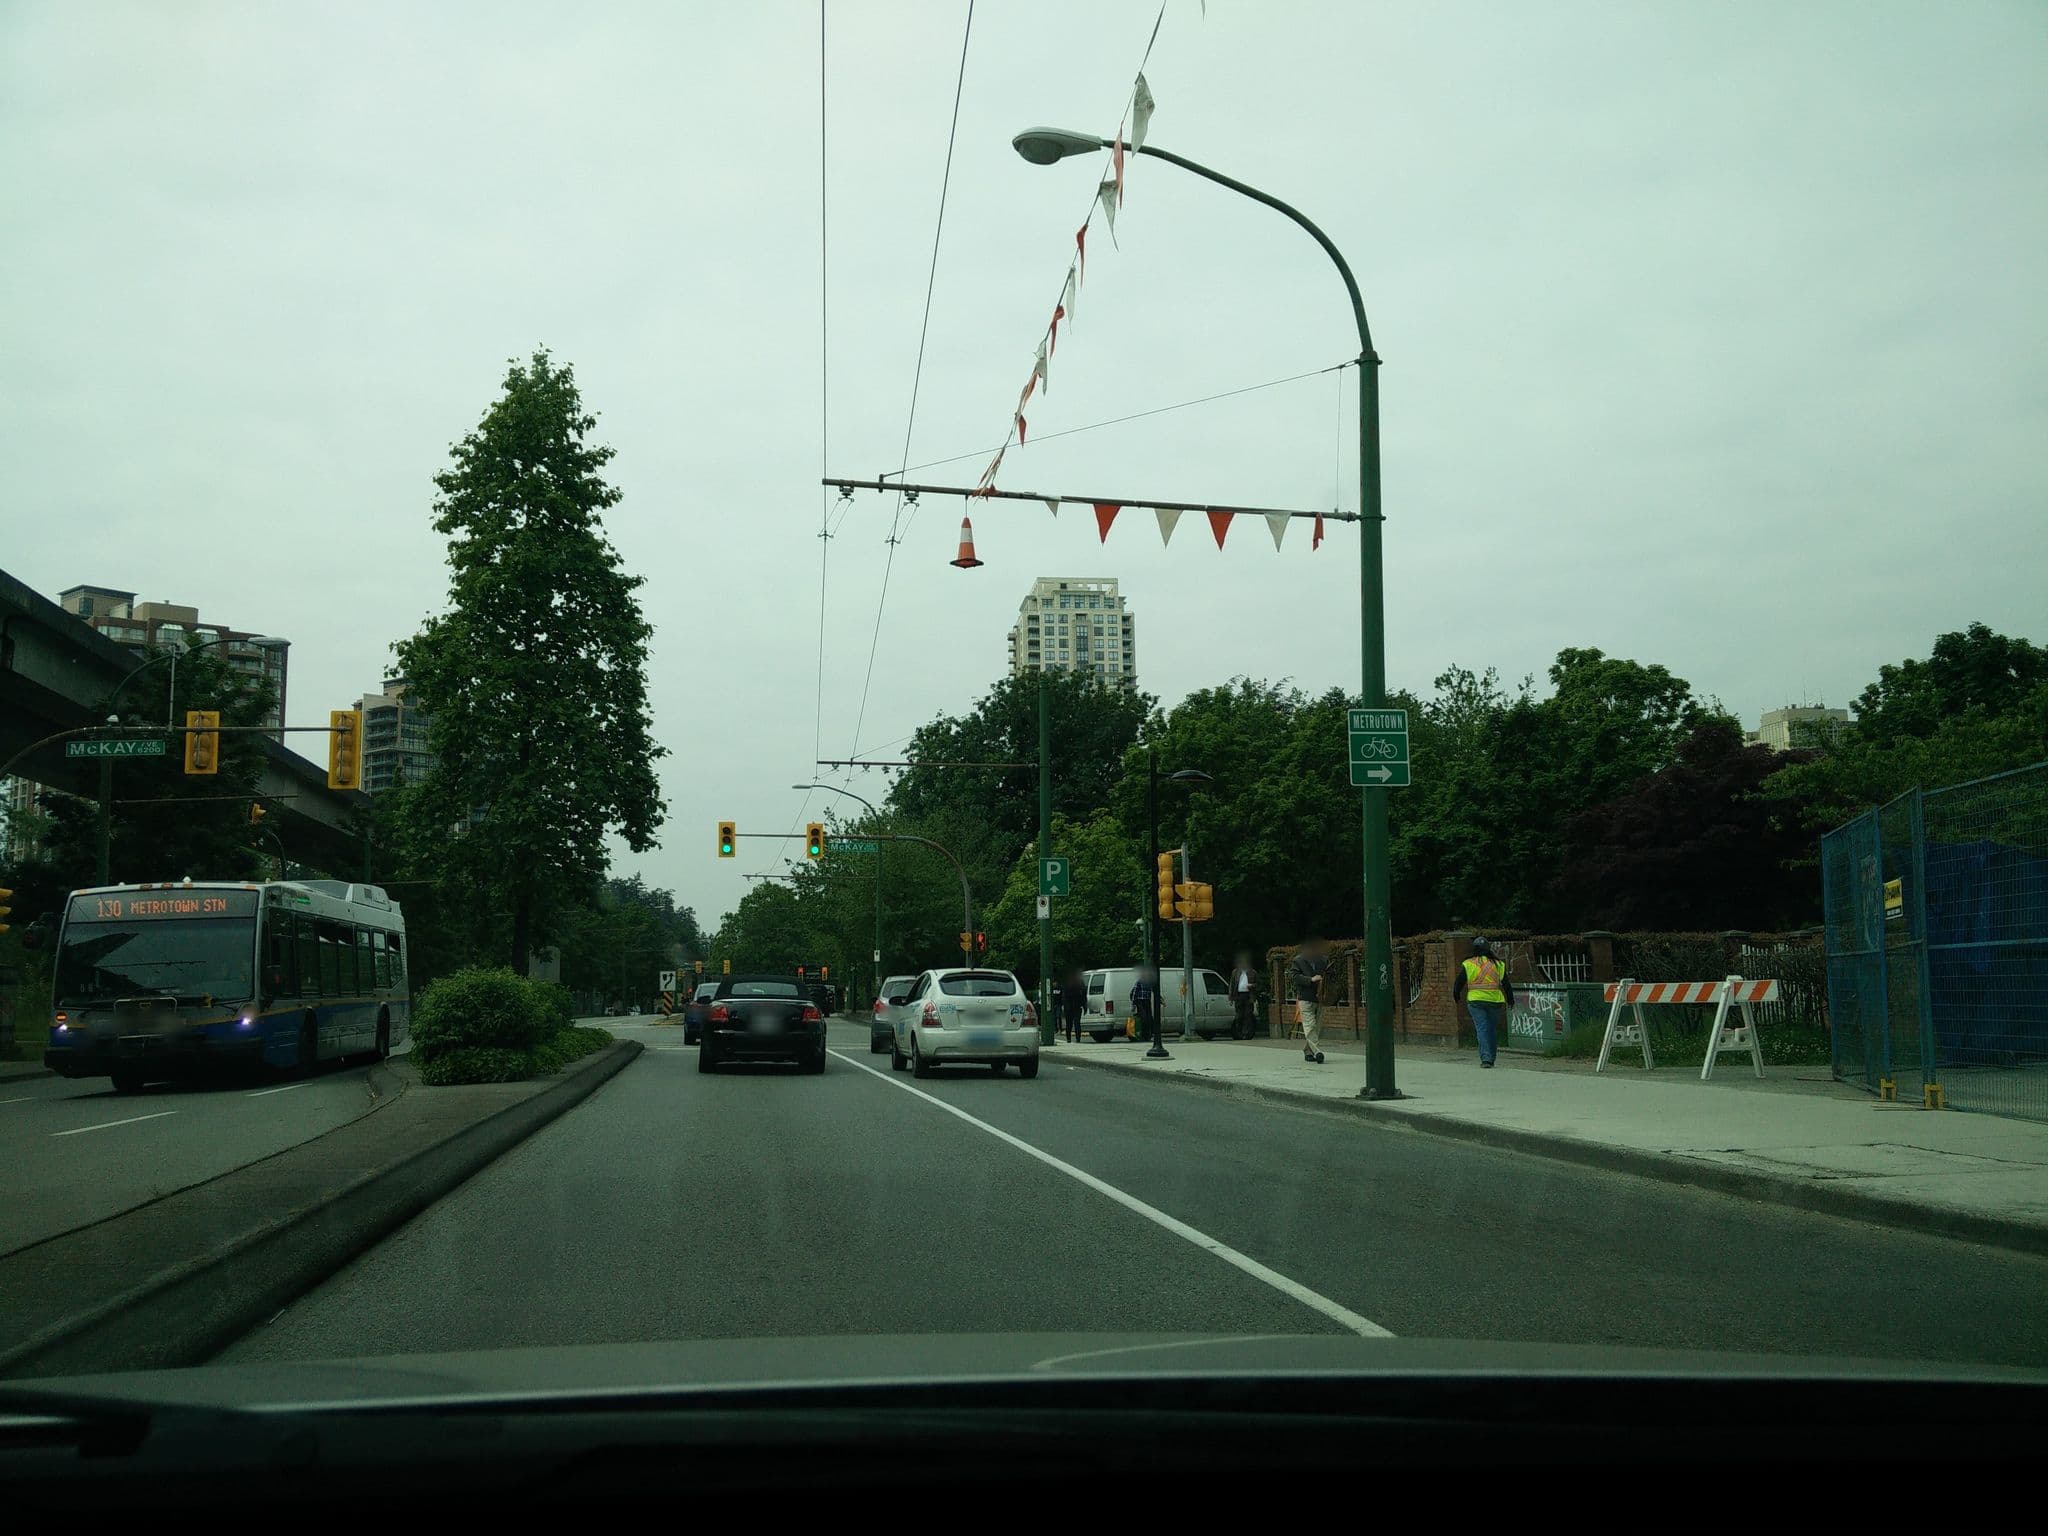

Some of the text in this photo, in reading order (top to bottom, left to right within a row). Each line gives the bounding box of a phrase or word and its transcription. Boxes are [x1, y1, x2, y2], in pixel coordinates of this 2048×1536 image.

[1353, 714, 1403, 729] METROTOWN
[70, 742, 136, 755] McKAY
[1046, 861, 1062, 881] P
[97, 898, 226, 917] 130 METROTOWN STN
